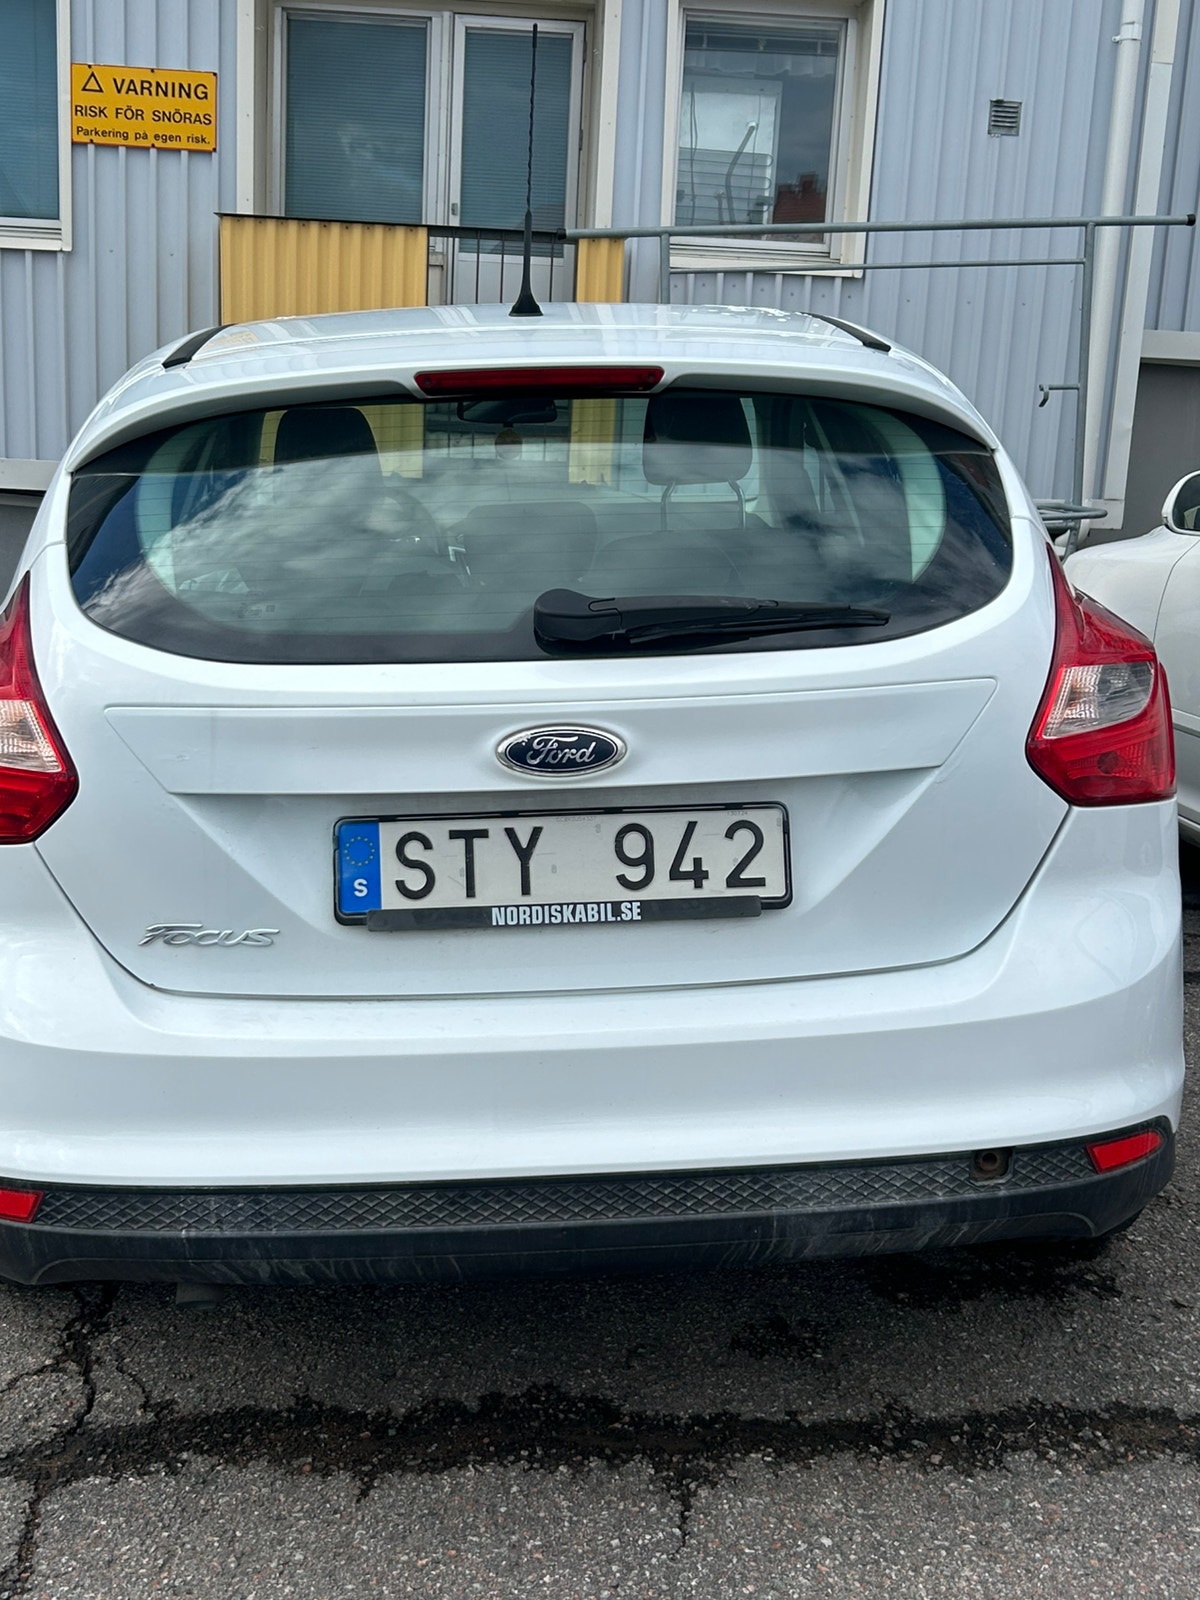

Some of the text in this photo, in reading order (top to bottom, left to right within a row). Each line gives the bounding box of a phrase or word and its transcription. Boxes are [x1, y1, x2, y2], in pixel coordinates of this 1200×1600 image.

[113, 78, 208, 100] VARNING
[74, 105, 212, 126] RISK FÖR SNÖRAS
[76, 126, 210, 145] Parkering på egen risk.
[526, 735, 597, 765] Ford
[395, 819, 767, 900] STY 942
[353, 878, 368, 898] S
[491, 901, 642, 926] NORDISKABIL.SE
